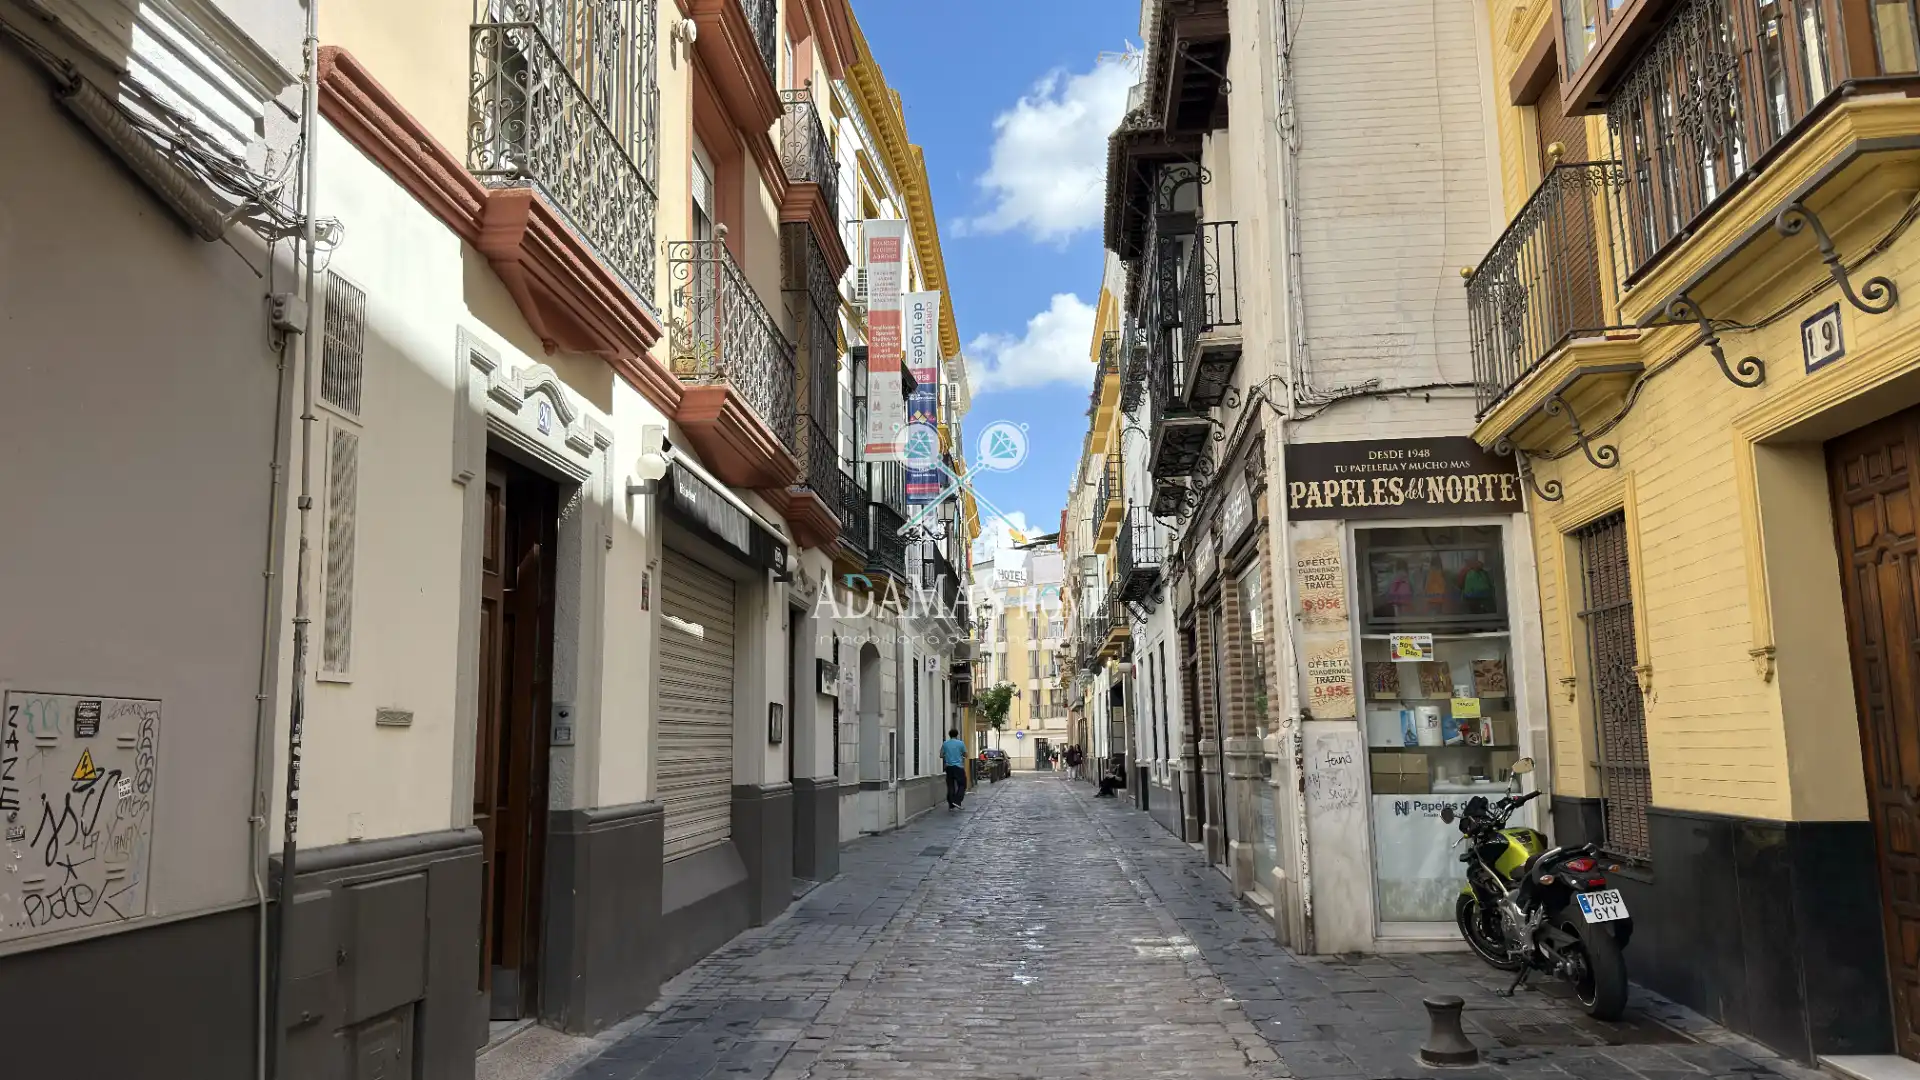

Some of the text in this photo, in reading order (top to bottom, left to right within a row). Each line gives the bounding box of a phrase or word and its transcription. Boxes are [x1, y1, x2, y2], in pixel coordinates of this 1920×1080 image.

[911, 302, 926, 365] de inglés
[1807, 321, 1833, 357] 19
[1368, 448, 1431, 460] DESDE 1948
[1334, 460, 1471, 473] TU PAPELERIA Y MUCHO MAS
[1289, 473, 1517, 509] PAPELES del NORTE
[1298, 558, 1339, 567] OFERTA
[997, 569, 1026, 581] HOTEL
[1305, 573, 1335, 582] TRAZOS
[1305, 581, 1336, 590] TRAVEL
[1308, 660, 1350, 668] OFERTA
[1309, 668, 1351, 676] CUADERNOS
[1315, 675, 1346, 684] TRAZOS
[1413, 800, 1458, 812] Papeles
[1587, 891, 1620, 907] 7069
[1593, 905, 1619, 920] GYY
